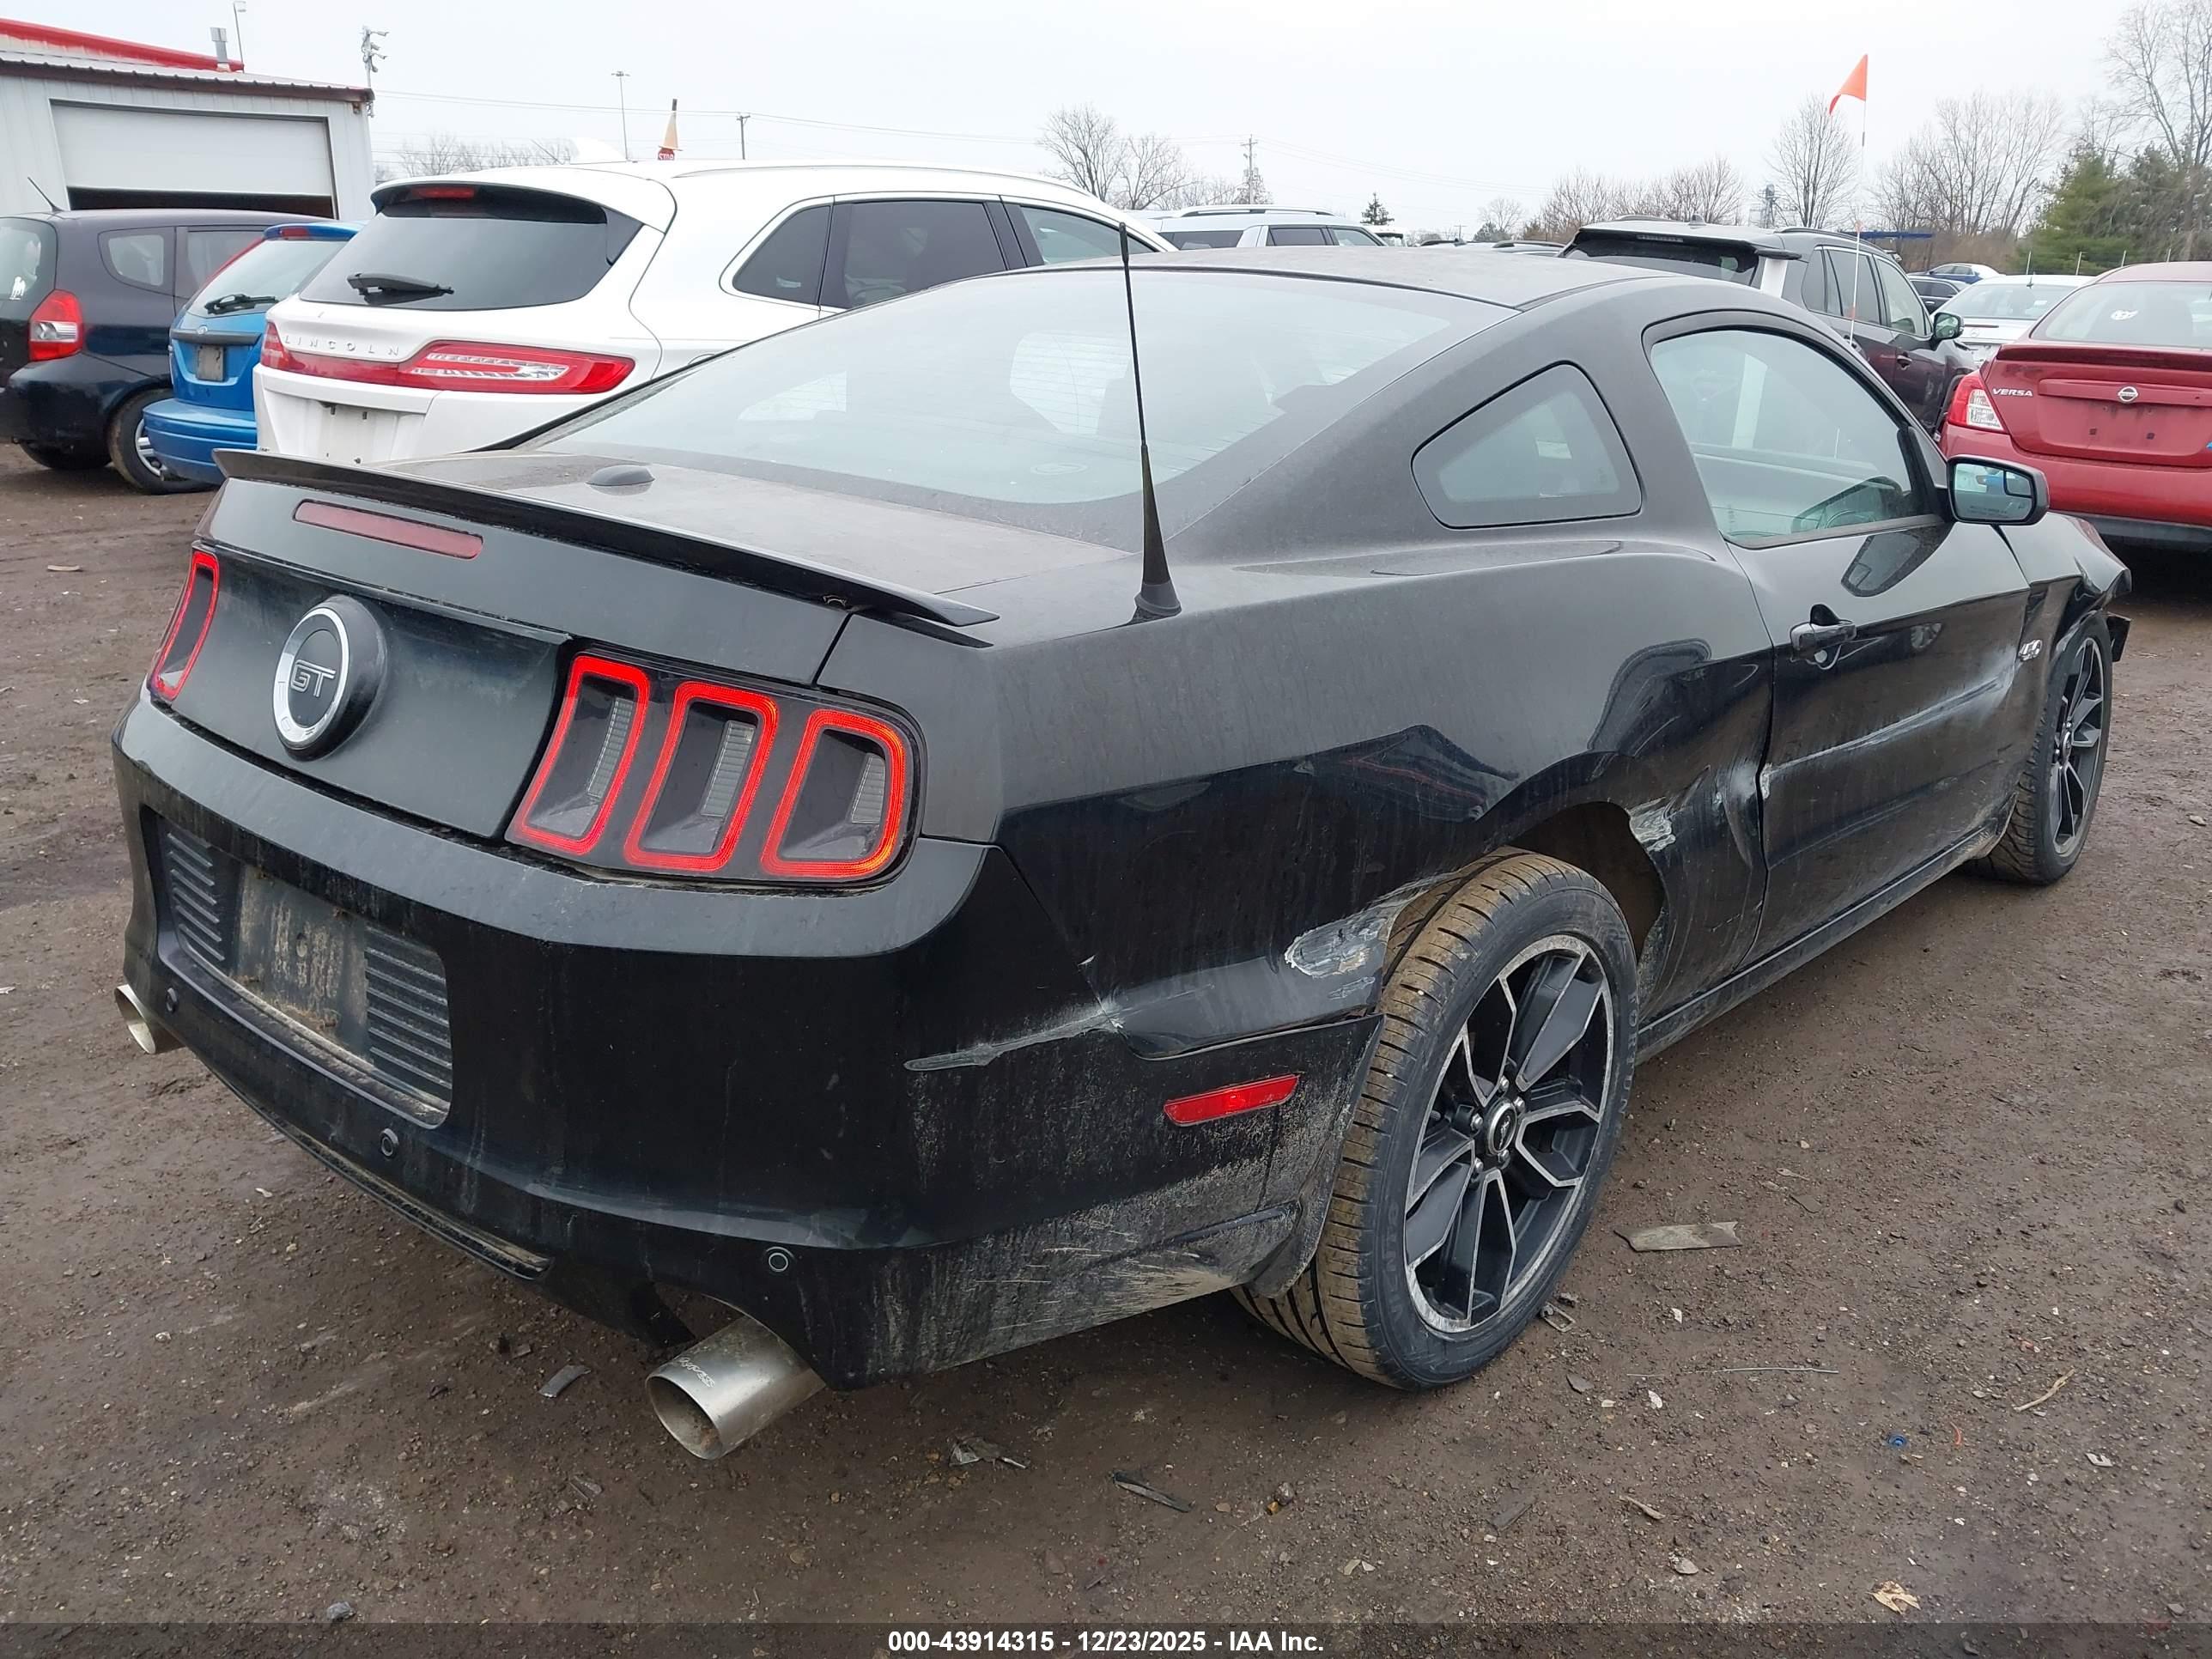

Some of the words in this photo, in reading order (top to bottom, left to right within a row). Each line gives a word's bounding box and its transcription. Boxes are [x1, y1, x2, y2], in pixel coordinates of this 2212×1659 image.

[284, 335, 399, 356] LINCOLN
[1992, 388, 2033, 397] VERSA
[290, 659, 337, 697] GT
